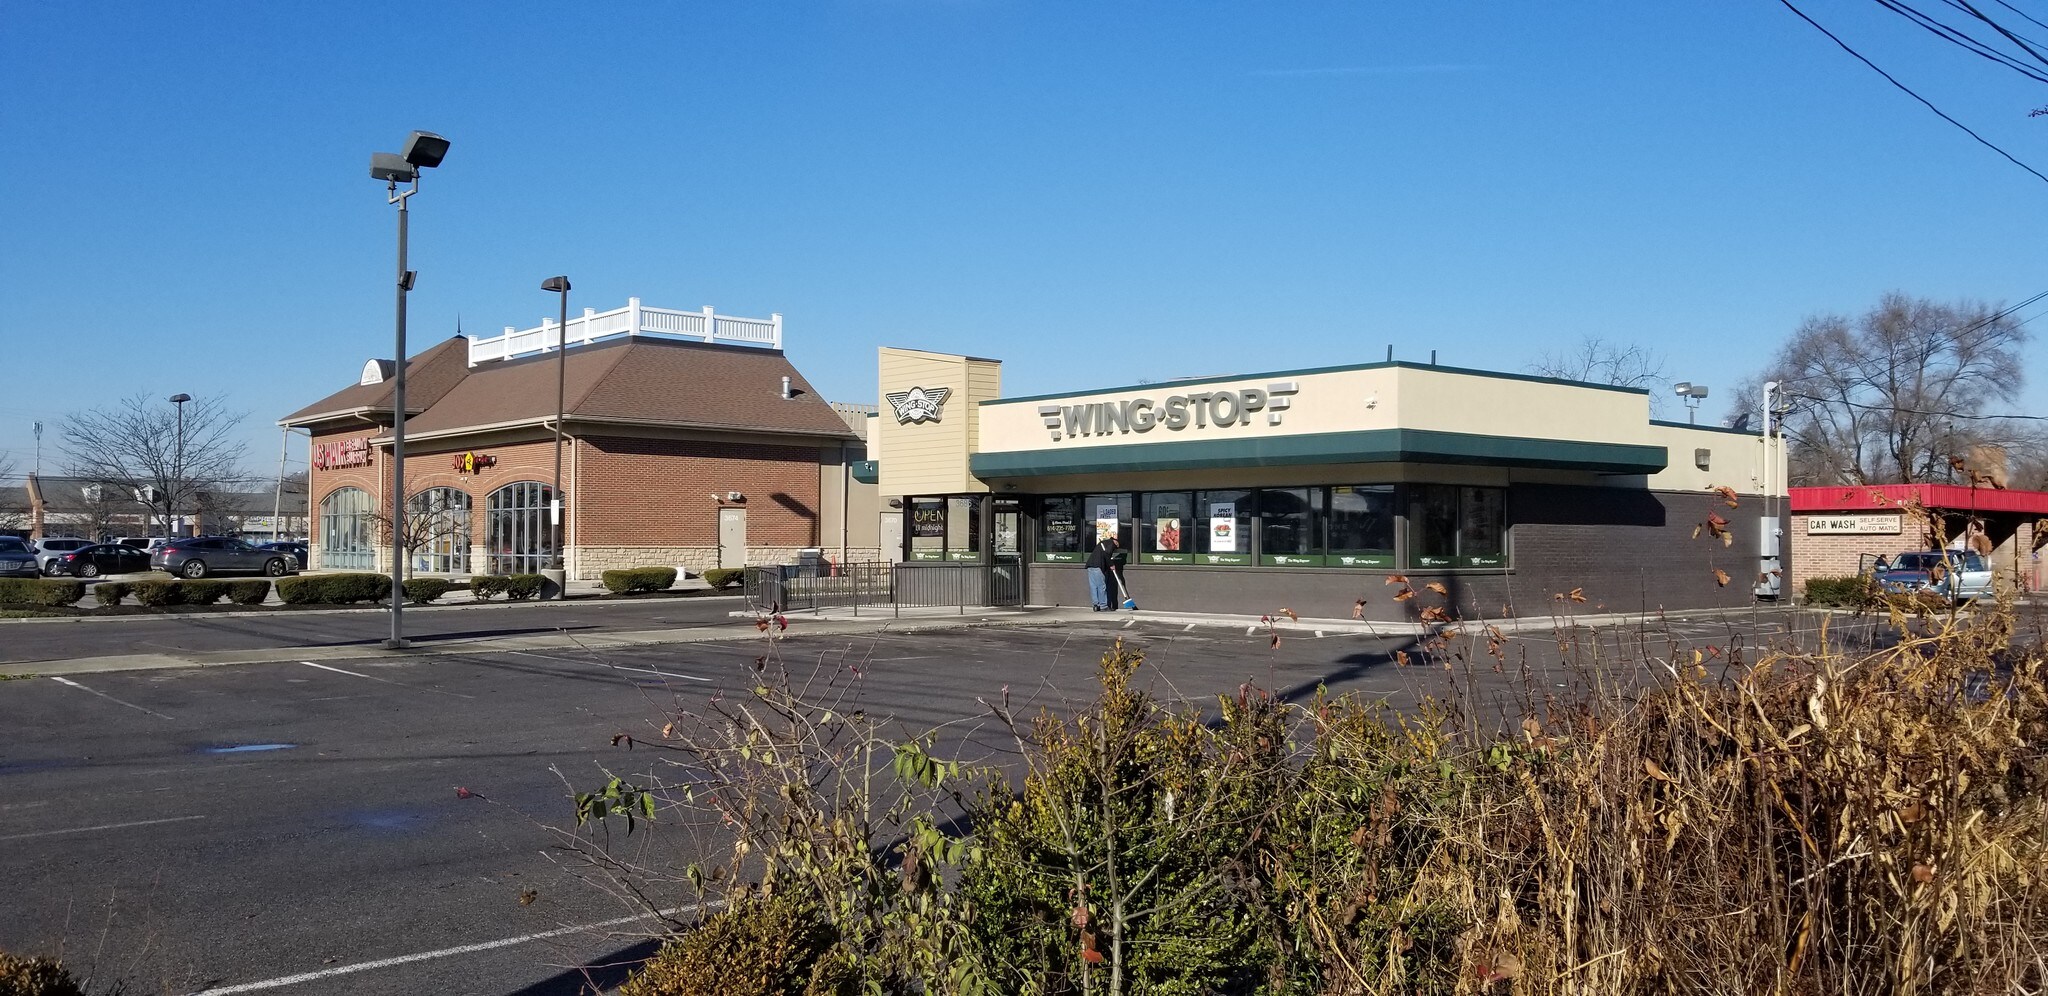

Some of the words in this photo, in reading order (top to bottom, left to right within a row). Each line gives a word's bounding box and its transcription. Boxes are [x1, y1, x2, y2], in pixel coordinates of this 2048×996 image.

[312, 444, 325, 468] US
[325, 441, 347, 467] HAIR
[914, 508, 944, 522] OPEN
[1810, 520, 1827, 529] CAR
[1830, 520, 1856, 529] WASH
